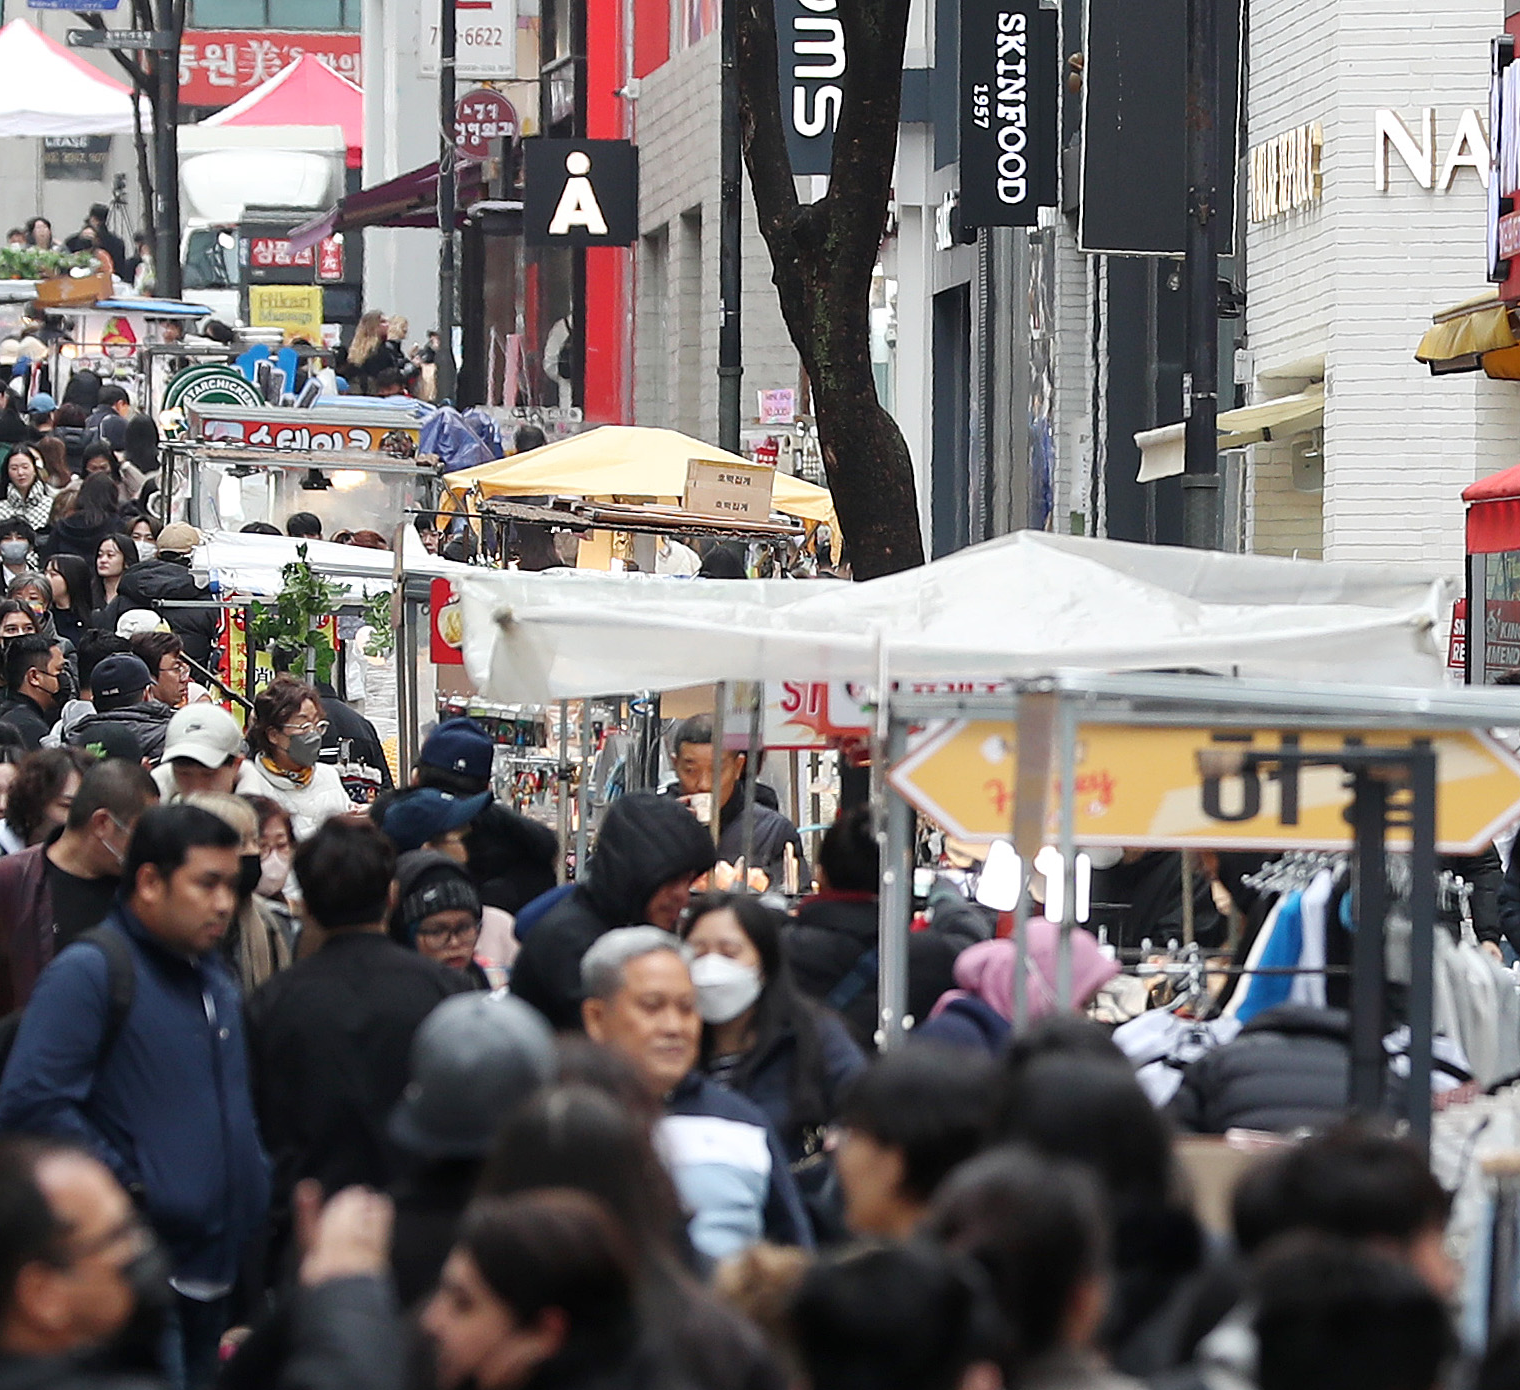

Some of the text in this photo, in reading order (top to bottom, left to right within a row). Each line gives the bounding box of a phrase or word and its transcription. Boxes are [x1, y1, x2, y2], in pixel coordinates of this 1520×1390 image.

[429, 25, 503, 46] 7-6622
[792, 0, 846, 138] ms
[973, 83, 990, 129] 1957
[997, 12, 1027, 204] SKINFOOD
